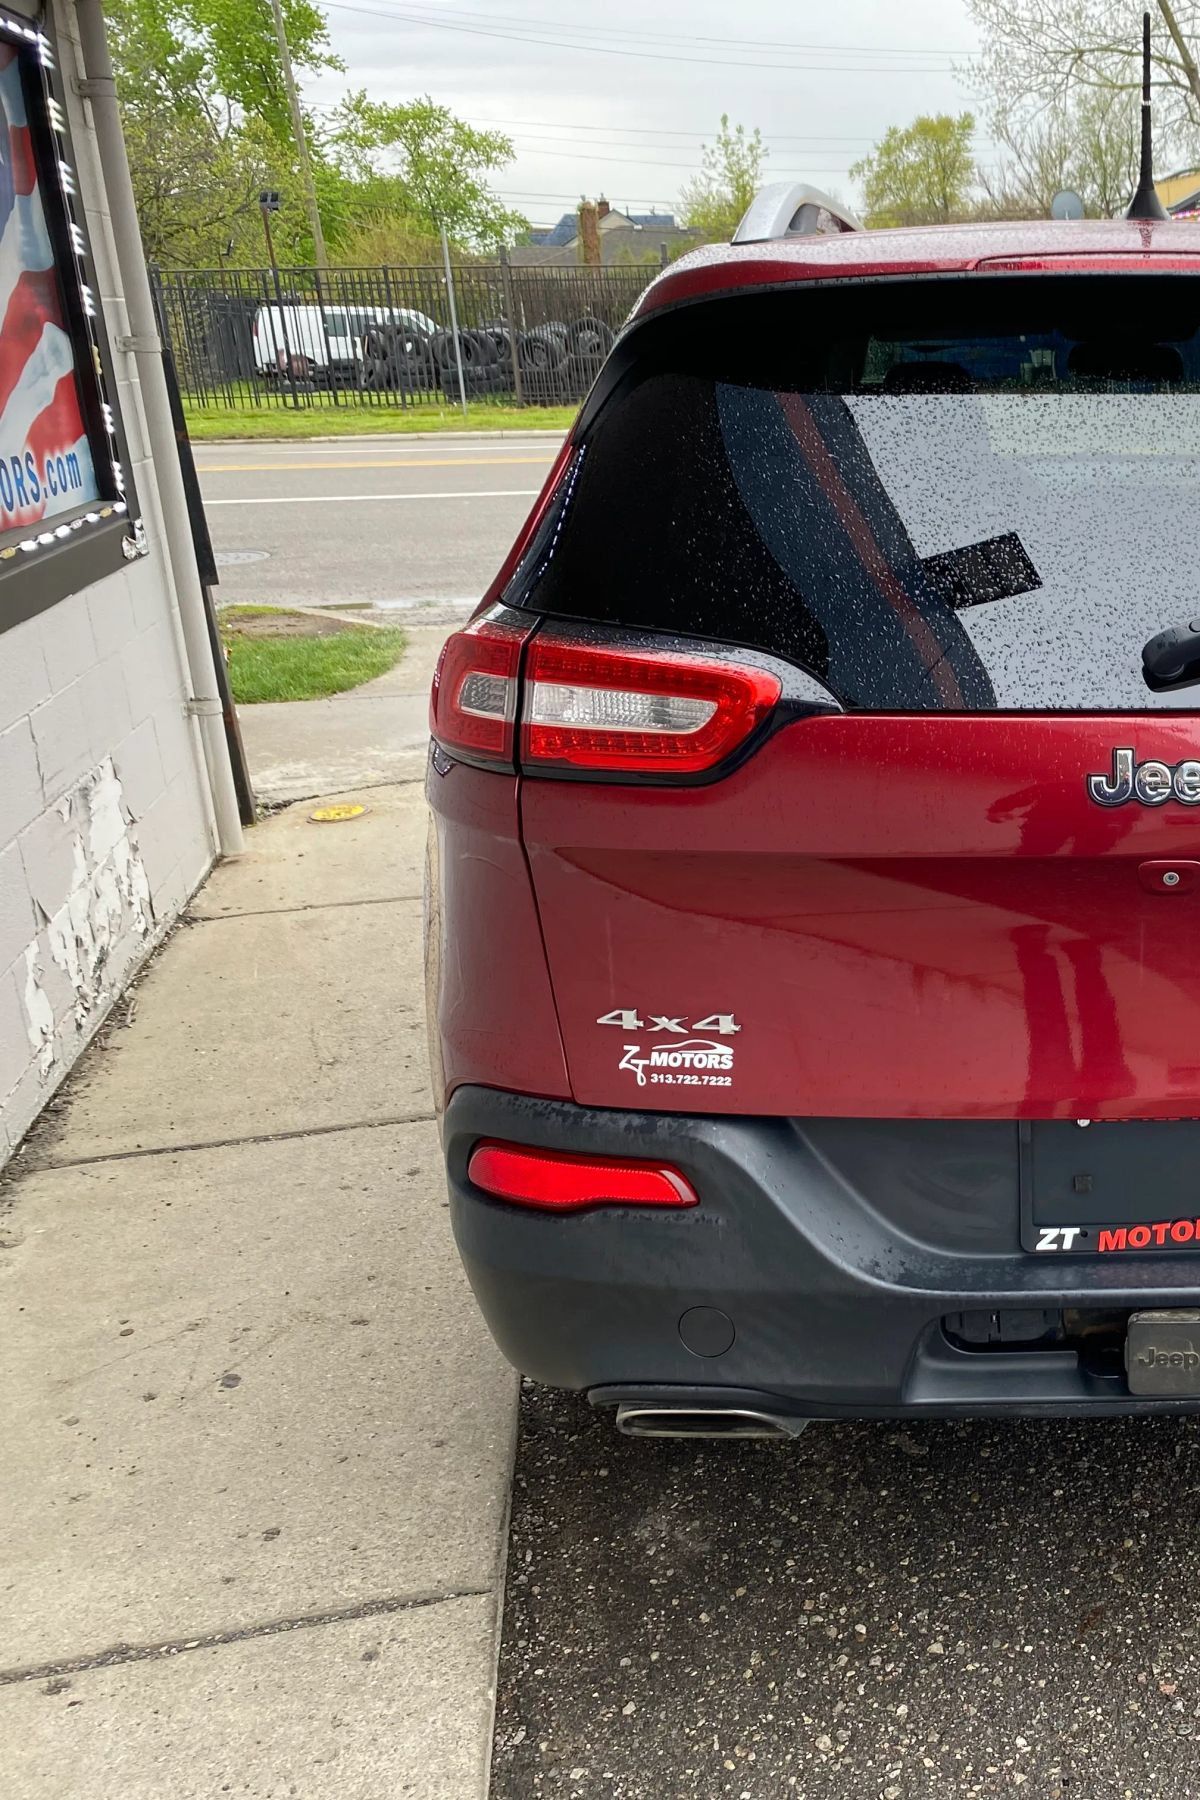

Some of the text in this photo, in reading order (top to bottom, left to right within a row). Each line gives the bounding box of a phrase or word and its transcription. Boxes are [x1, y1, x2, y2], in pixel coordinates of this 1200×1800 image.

[650, 1051, 734, 1070] MOTORS
[650, 1073, 733, 1087] 313.722.7222
[1035, 1227, 1081, 1251] ZT
[1138, 1346, 1200, 1370] Jeep
